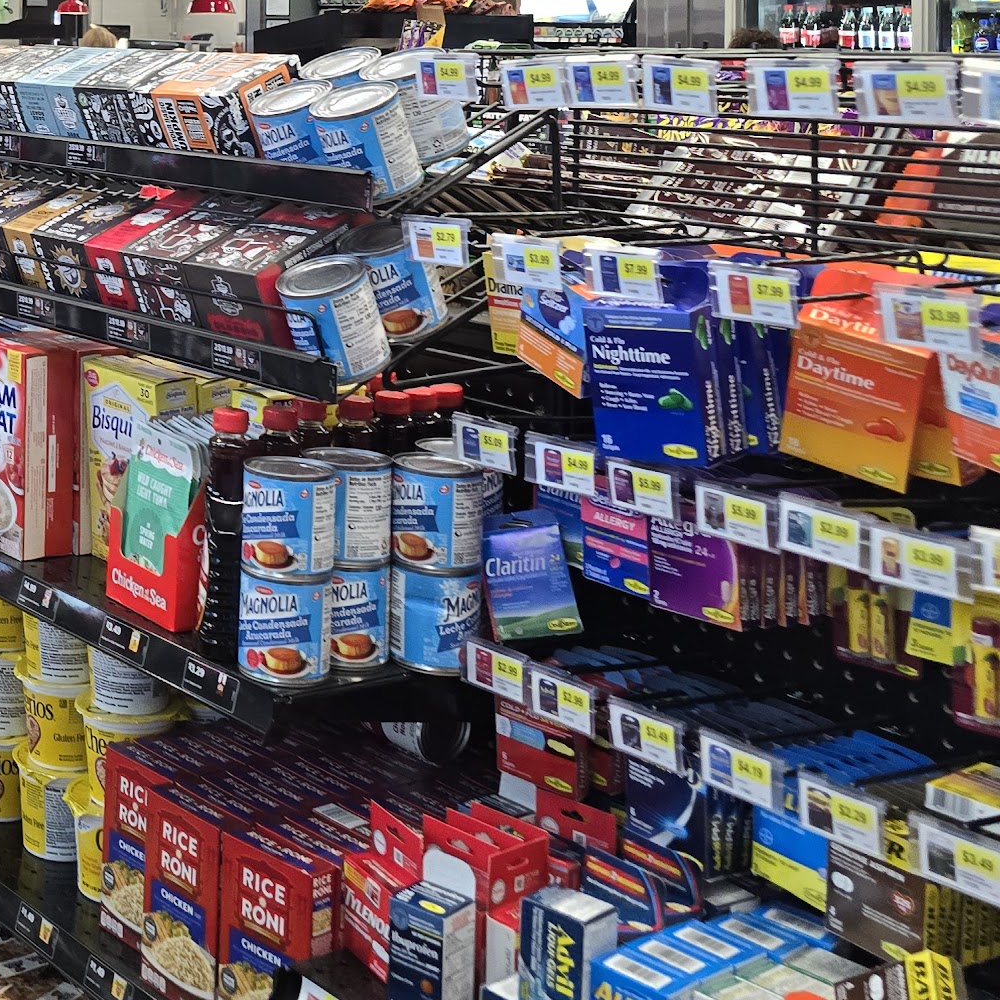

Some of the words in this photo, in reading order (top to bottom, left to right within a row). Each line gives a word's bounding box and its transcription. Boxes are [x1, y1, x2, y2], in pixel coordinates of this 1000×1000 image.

[439, 67, 459, 78] $4.99
[529, 73, 552, 85] $4.99
[597, 70, 620, 82] $4.99
[677, 74, 701, 87] $4.99
[793, 76, 822, 89] $4.99
[904, 80, 937, 94] $4.99
[165, 102, 188, 150] UMPKIN
[435, 231, 456, 243] $2.79
[528, 253, 550, 265] $3.99
[623, 263, 648, 276] $7.99
[488, 278, 523, 296] Drama
[756, 284, 784, 298] $7.99
[929, 309, 961, 324] $3.99
[592, 344, 671, 366] Nighttime
[796, 355, 876, 390] Daytime
[140, 389, 150, 399] 30
[105, 399, 131, 412] ORIGINAL
[92, 405, 133, 439] Bisqui
[567, 457, 589, 470] $4.99
[638, 478, 661, 491] $5.99
[593, 511, 636, 531] ALLERGY
[485, 555, 547, 577] Claritin
[111, 567, 146, 600] Chicken
[149, 588, 167, 612] Sea
[246, 618, 308, 631] Condensada
[439, 622, 465, 636] Leche
[497, 661, 517, 676] $2.99
[118, 804, 147, 833] RON
[162, 821, 198, 858] RICE
[119, 839, 146, 862] CHICKE
[161, 850, 197, 887] RONI
[242, 867, 286, 906] RICE
[313, 873, 332, 888] RICE
[160, 888, 194, 916] CHICKEN
[241, 897, 285, 937] RONI
[344, 889, 391, 940] TYLENOL
[241, 937, 281, 967] CHICKEN
[392, 930, 438, 961] Ibuprofen
[555, 923, 577, 999] Advil
